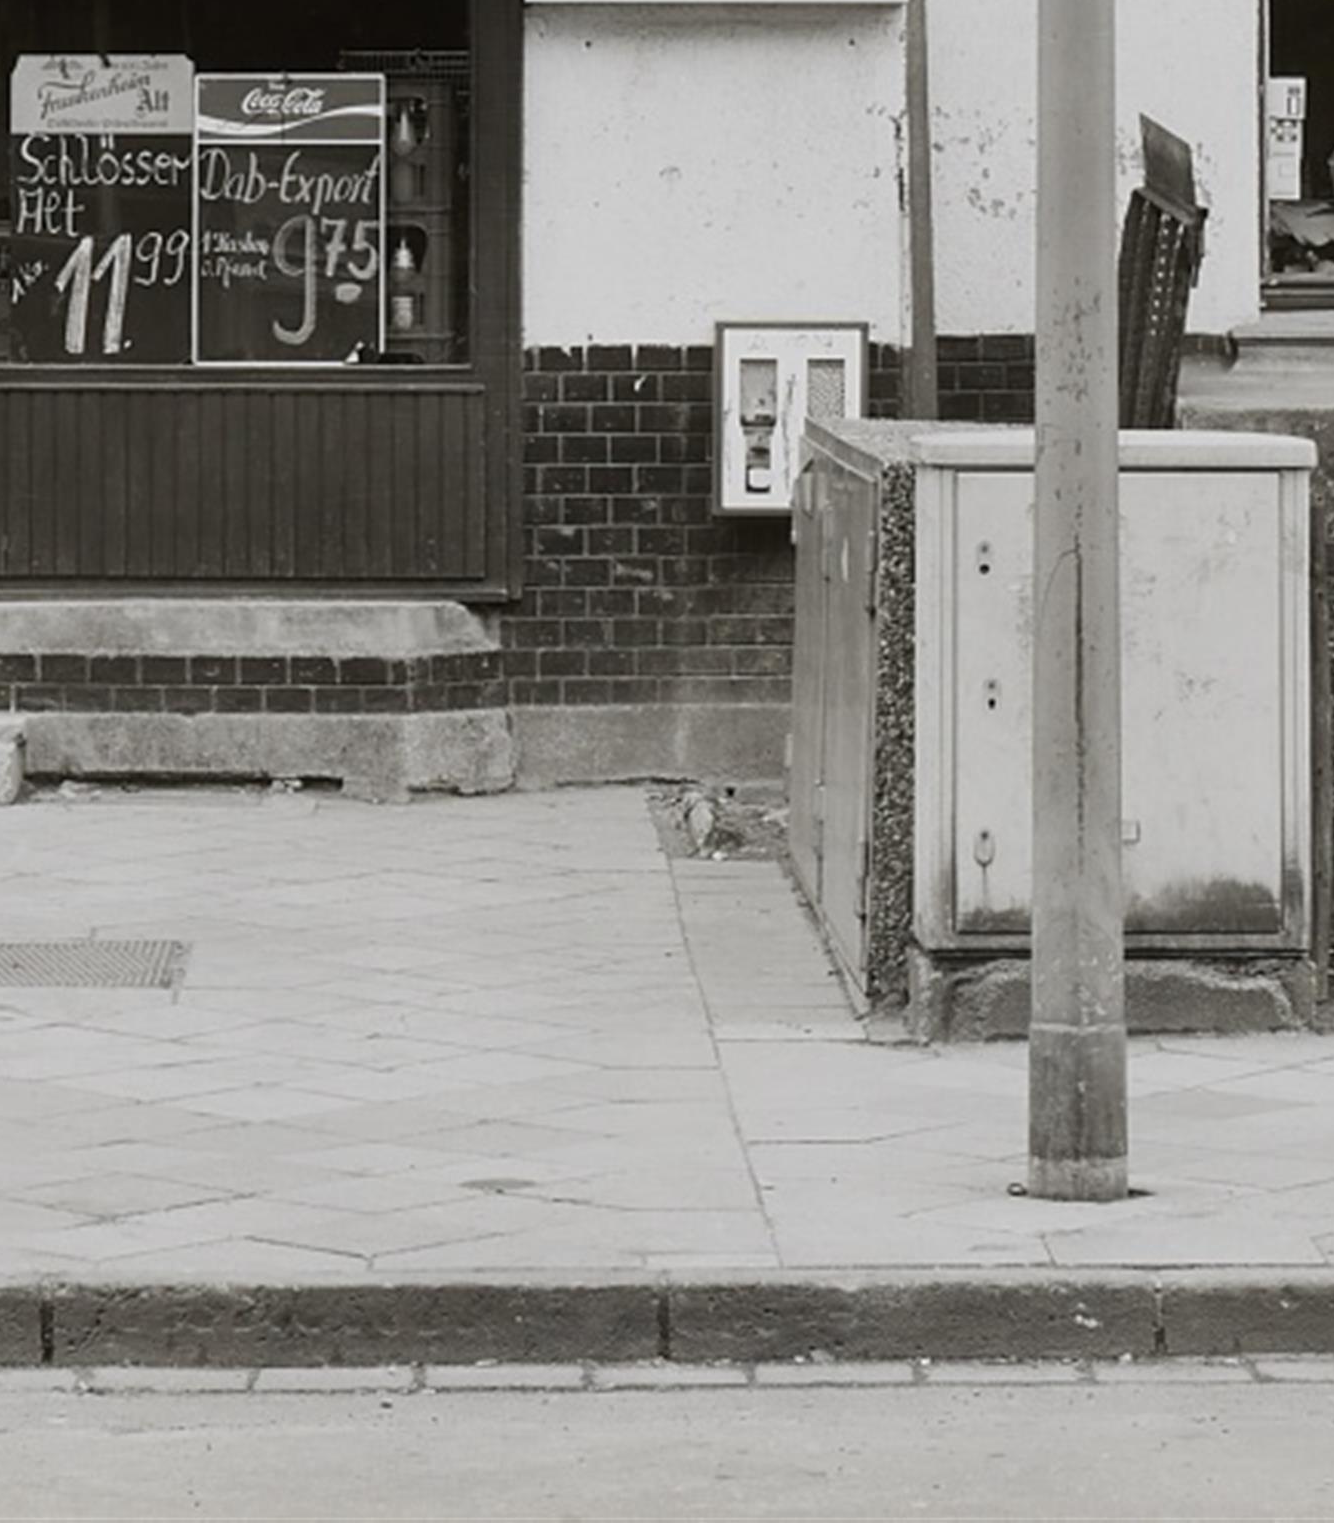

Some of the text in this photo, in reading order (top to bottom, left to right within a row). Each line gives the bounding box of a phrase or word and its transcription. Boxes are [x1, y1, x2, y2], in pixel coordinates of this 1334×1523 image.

[136, 88, 171, 115] Alt
[16, 134, 192, 186] Schlösser
[199, 147, 381, 216] Dab-Export
